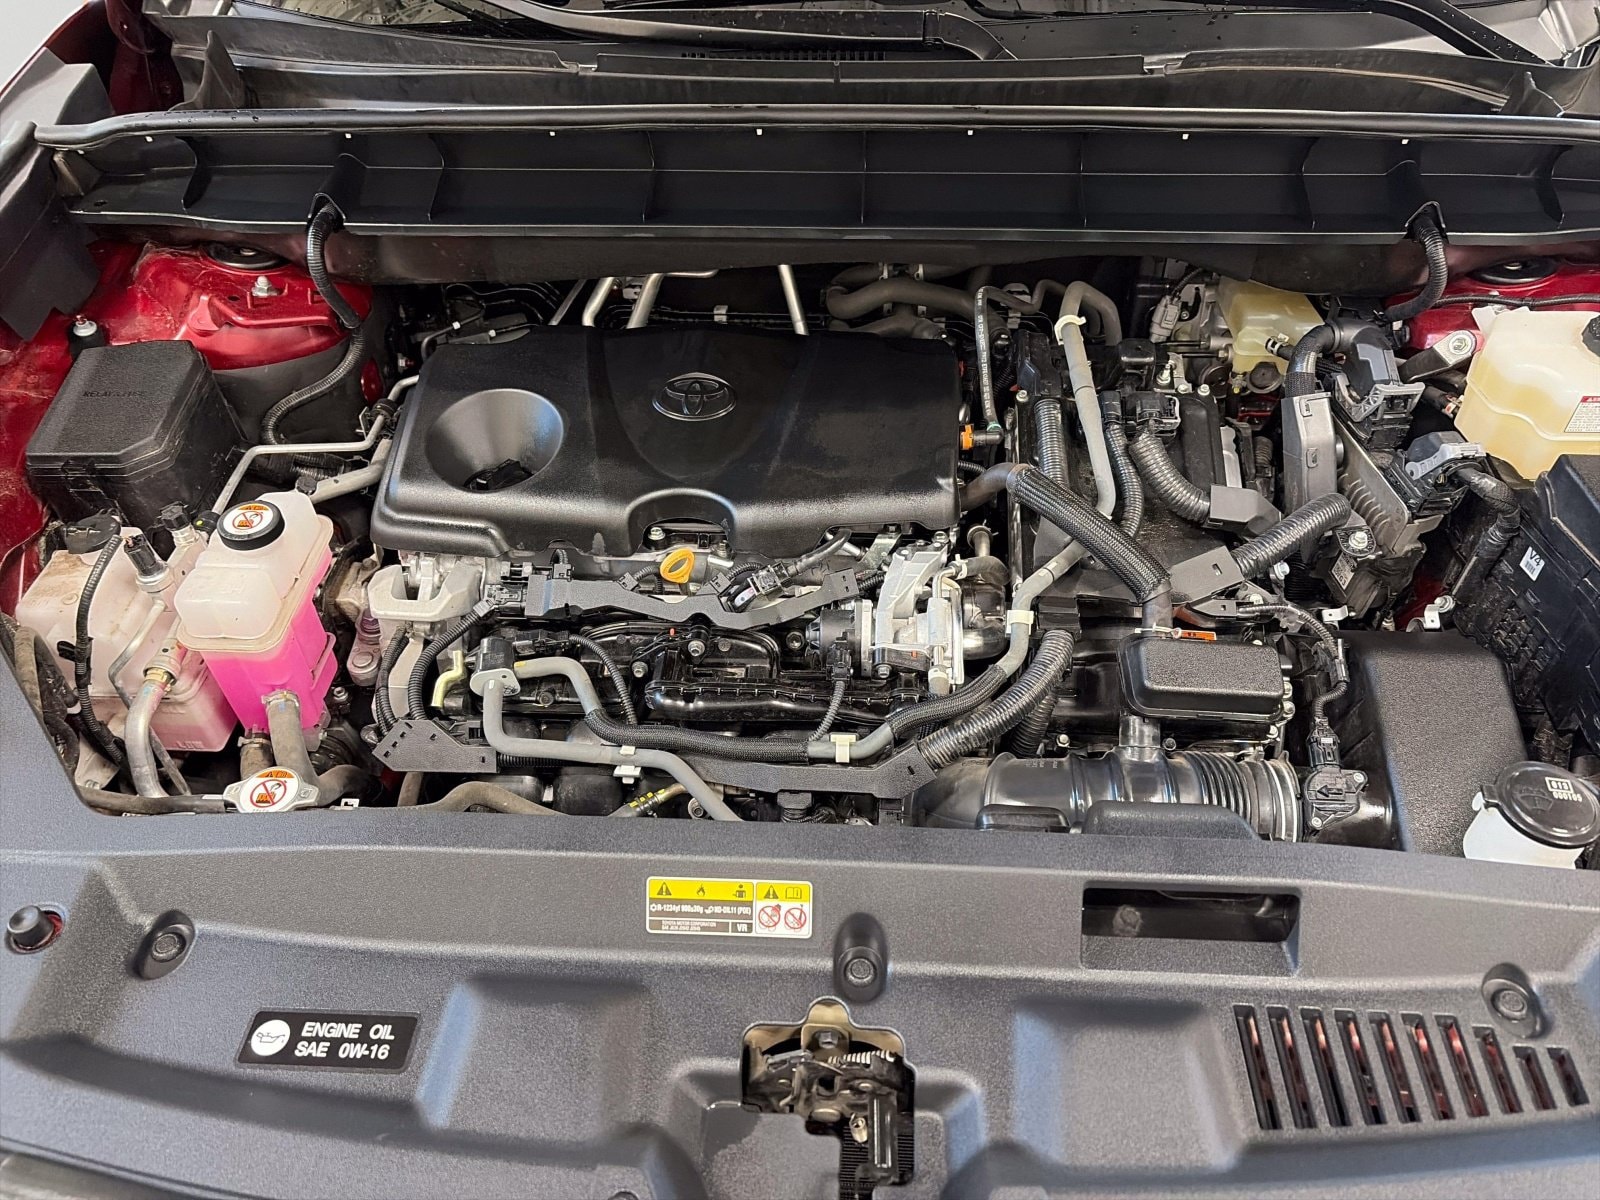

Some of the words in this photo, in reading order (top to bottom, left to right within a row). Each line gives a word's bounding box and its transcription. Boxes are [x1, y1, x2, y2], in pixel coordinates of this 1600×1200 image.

[737, 923, 748, 932] VR
[301, 1022, 362, 1039] ENGINE
[369, 1024, 395, 1041] OIL
[294, 1041, 330, 1058] SAE
[338, 1043, 390, 1060] 0W-16
